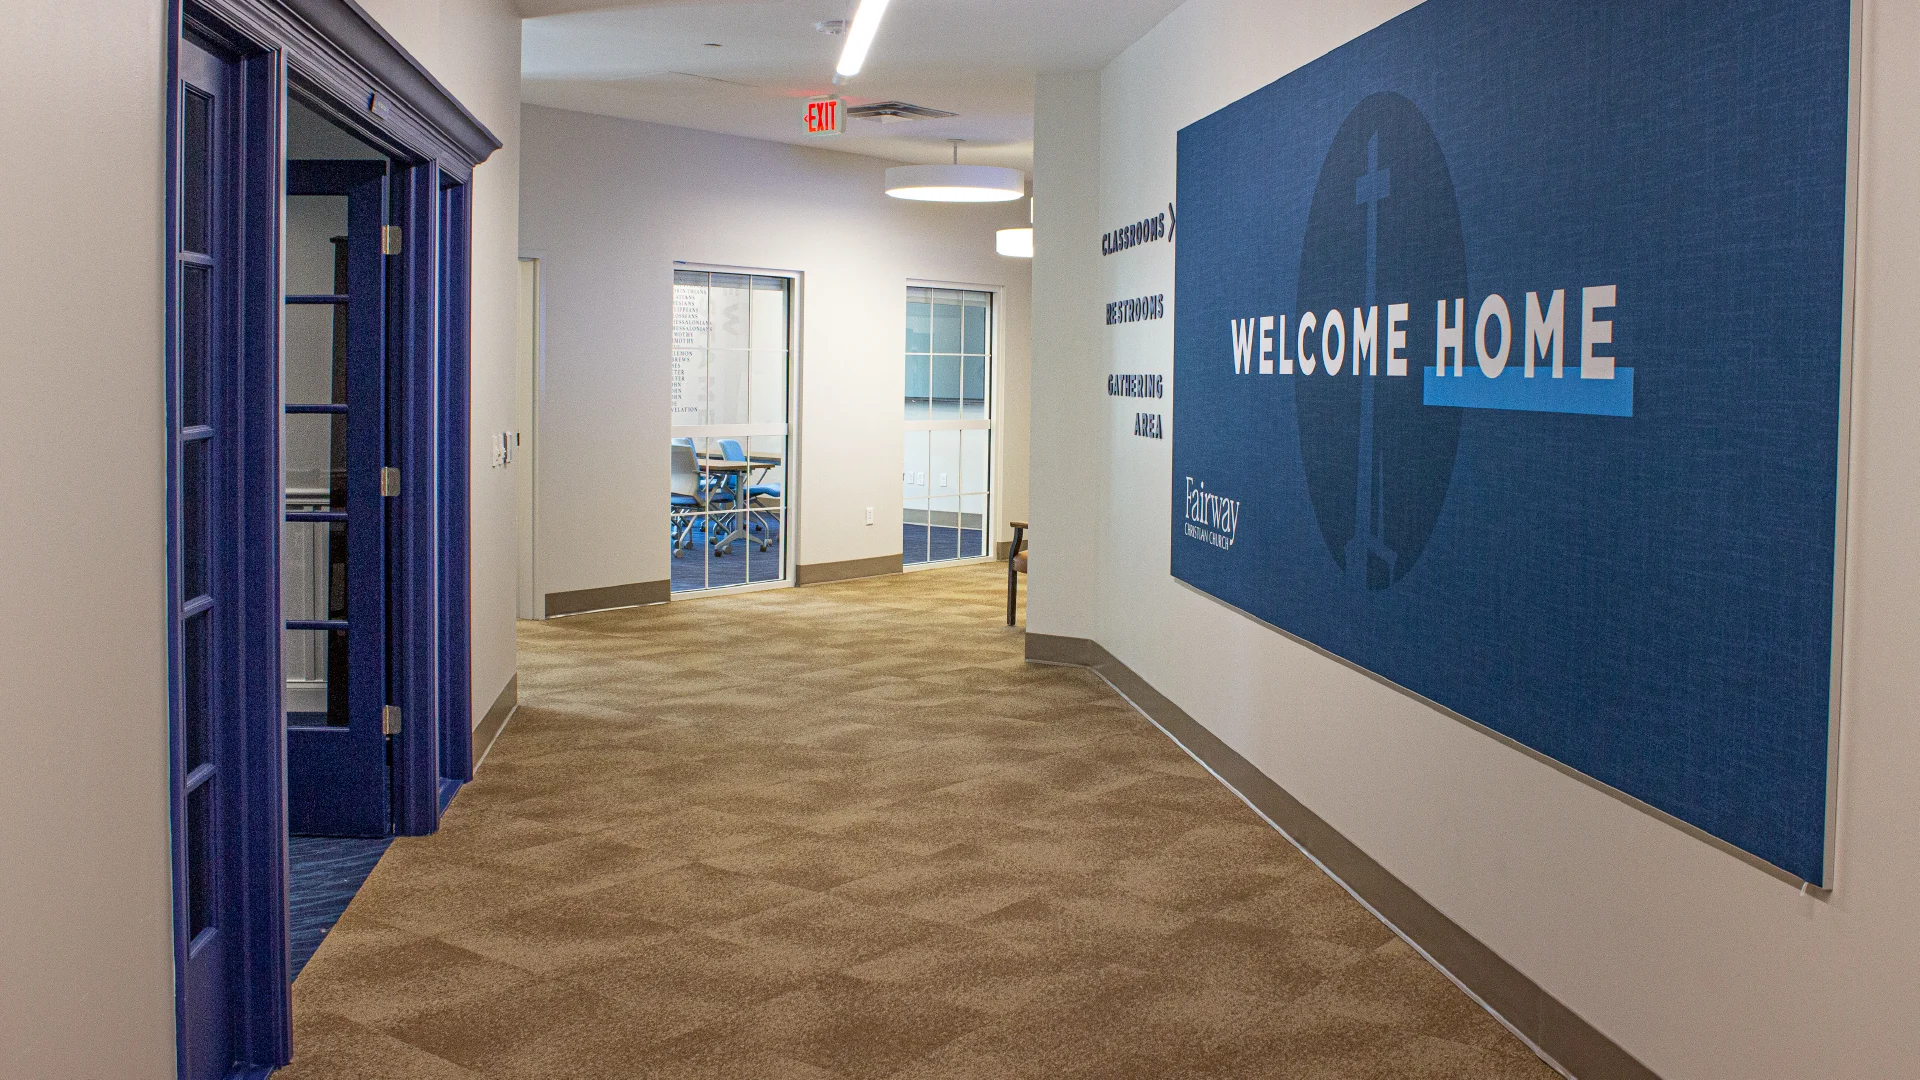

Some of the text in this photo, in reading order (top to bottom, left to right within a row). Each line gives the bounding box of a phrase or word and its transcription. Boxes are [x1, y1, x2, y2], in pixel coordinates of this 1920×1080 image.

[808, 101, 837, 133] EXIT
[1101, 212, 1165, 256] CLASSROOMS
[1106, 293, 1164, 325] RESTROOMS
[1231, 284, 1617, 380] WELCOME HOME
[1107, 373, 1164, 399] GATHERING
[1134, 412, 1163, 440] AREA
[1185, 476, 1241, 546] Fairway
[1184, 522, 1229, 551] CHRISTIAN CHURCH
